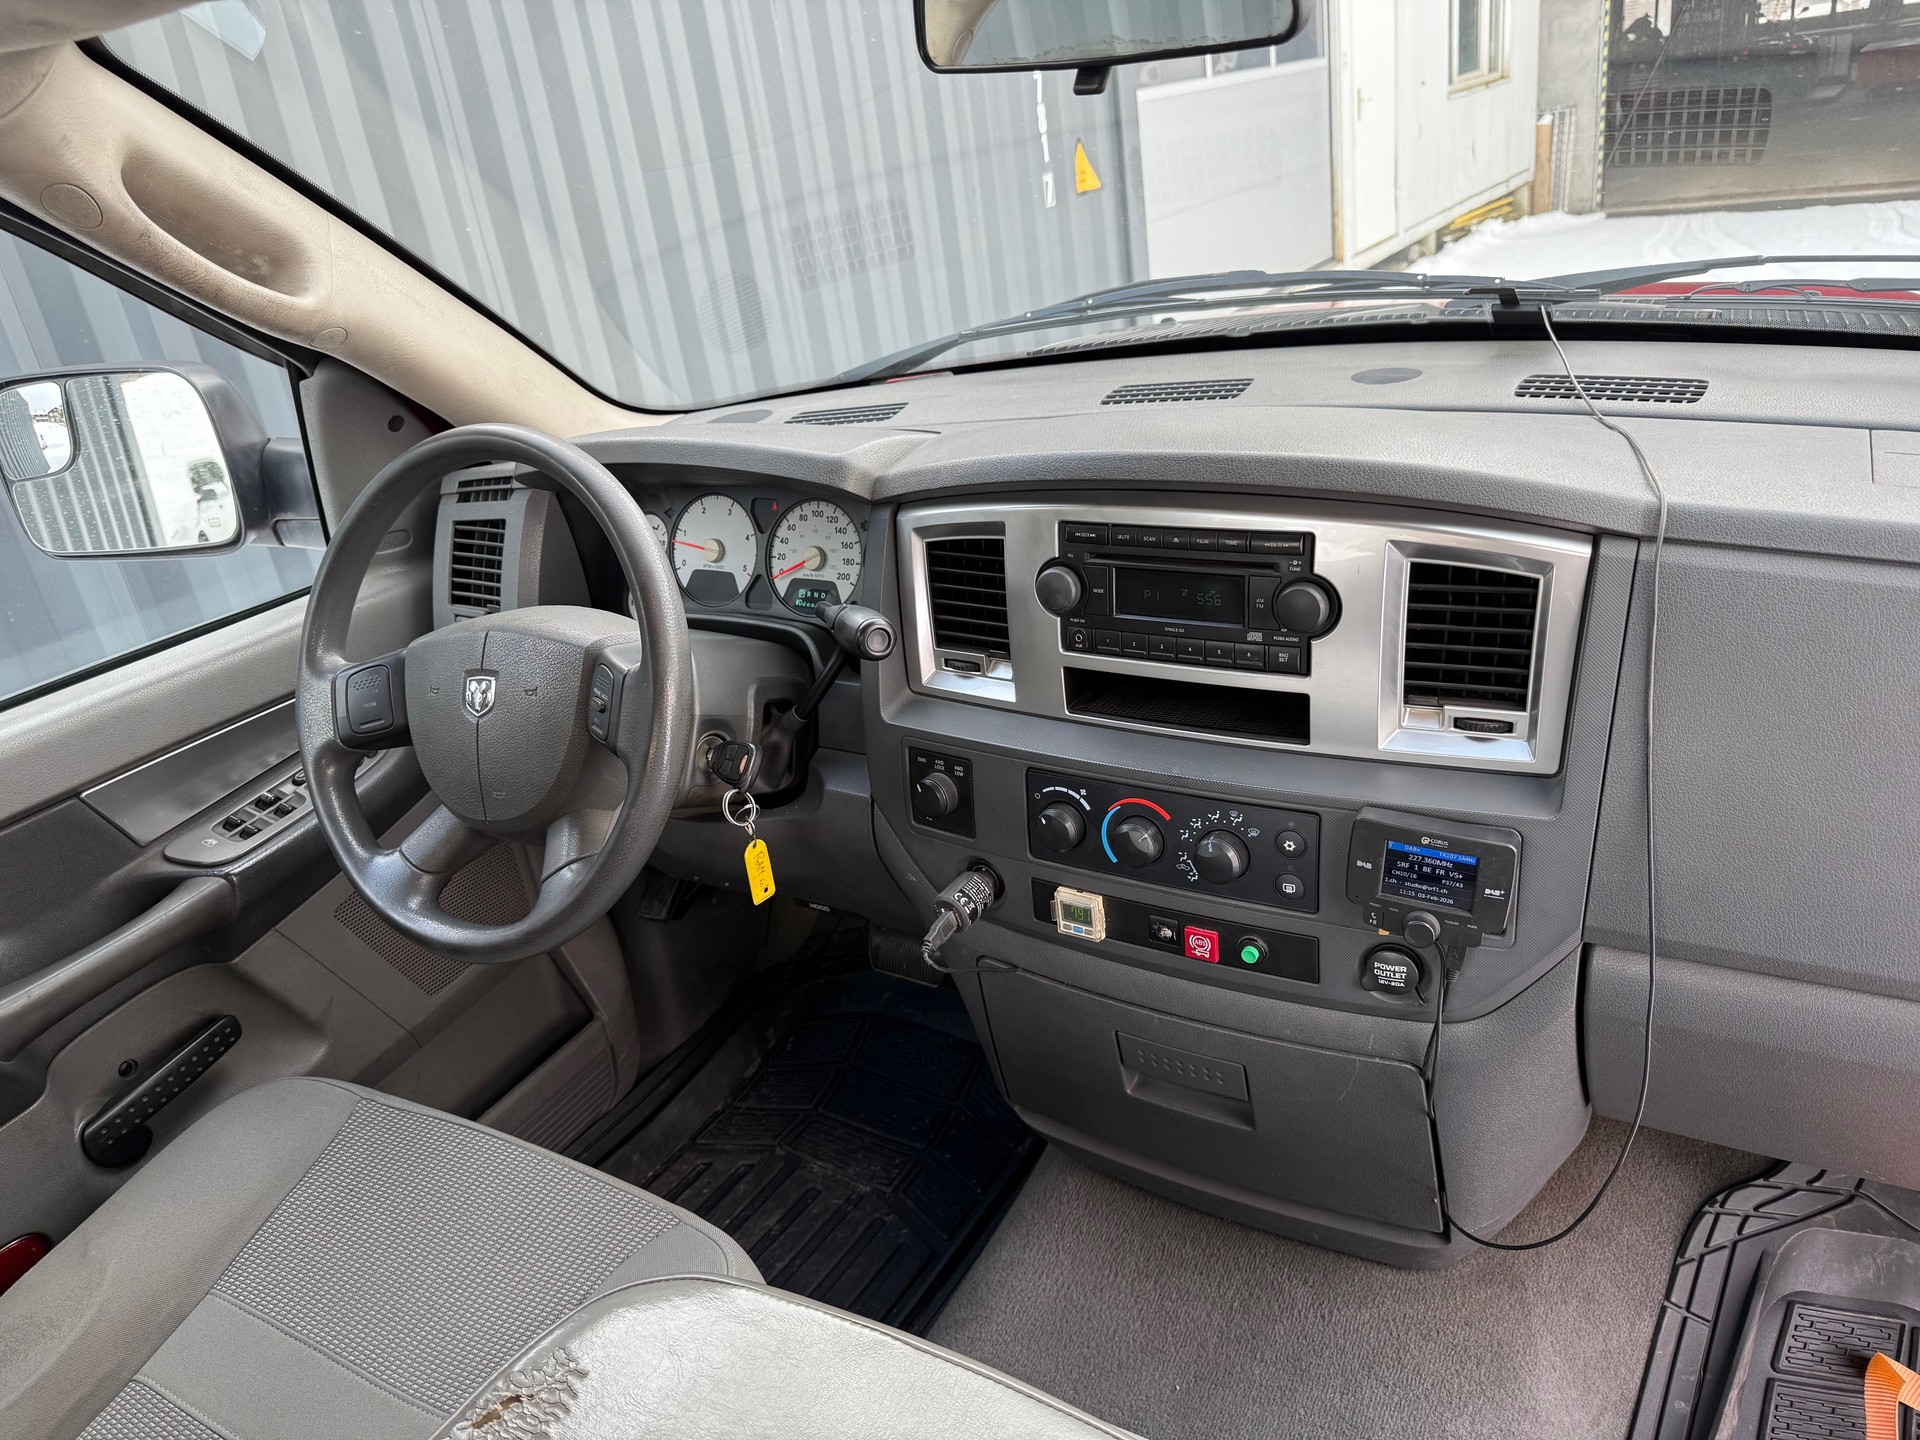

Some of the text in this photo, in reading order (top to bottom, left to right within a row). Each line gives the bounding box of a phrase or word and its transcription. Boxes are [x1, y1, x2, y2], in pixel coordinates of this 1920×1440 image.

[701, 506, 707, 515] 2
[727, 508, 733, 516] 3
[811, 509, 824, 518] 100
[799, 513, 808, 522] 80
[826, 515, 839, 524] 120
[787, 523, 796, 532] 60
[834, 526, 847, 535] 140
[779, 537, 789, 545] 40
[841, 541, 854, 550] 160
[777, 552, 786, 561] 20
[681, 559, 687, 567] 0
[842, 557, 855, 566] 180
[742, 564, 748, 572] 5
[836, 572, 851, 581] 200
[1430, 838, 1449, 846] CORUS
[1408, 853, 1453, 869] 227.360MHz
[1439, 851, 1476, 863] TX107.5MHz
[1391, 869, 1417, 879] CH10/16
[1396, 860, 1410, 869] SRF
[1422, 866, 1432, 874] BE
[1435, 868, 1445, 876] FR
[1449, 871, 1463, 879] VS+
[1404, 881, 1448, 894] studio@srf1.ch
[1441, 879, 1464, 888] P37/43
[1399, 888, 1454, 905] 11:15 03-Feb-2026
[808, 902, 831, 912] HOOD
[1194, 938, 1207, 947] ABS
[1374, 961, 1407, 973] POWER
[1374, 968, 1407, 980] OUTLET
[1377, 978, 1405, 987] 12V-20A
